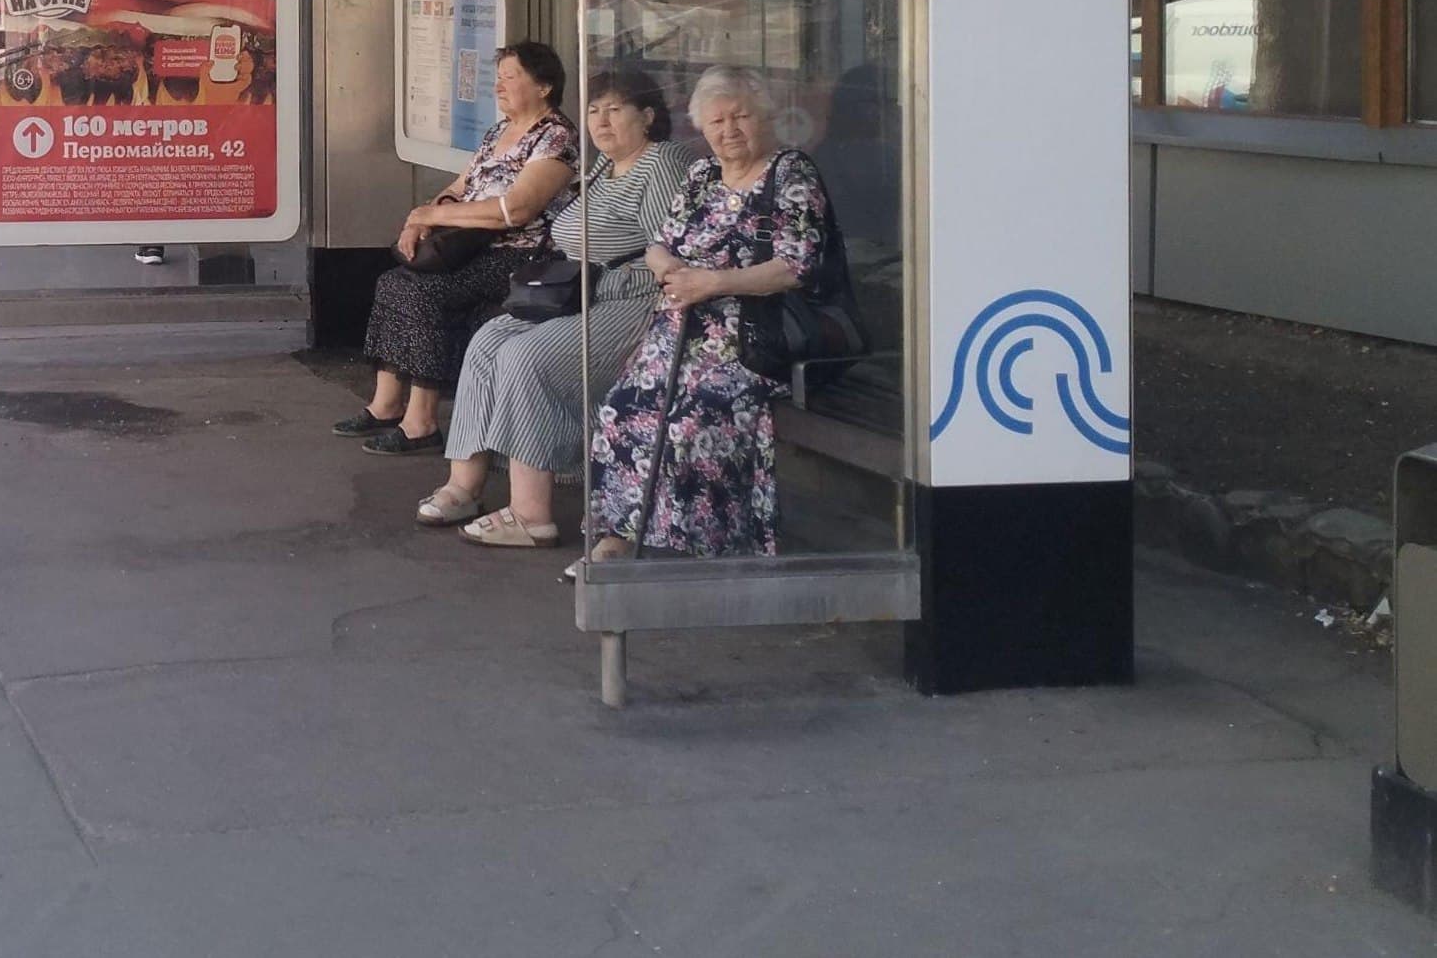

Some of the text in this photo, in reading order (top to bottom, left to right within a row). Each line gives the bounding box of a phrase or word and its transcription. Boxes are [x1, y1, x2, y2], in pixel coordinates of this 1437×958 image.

[16, 74, 32, 86] 6+
[63, 116, 208, 141] 160 метров
[63, 141, 245, 163] Первомайская, 42
